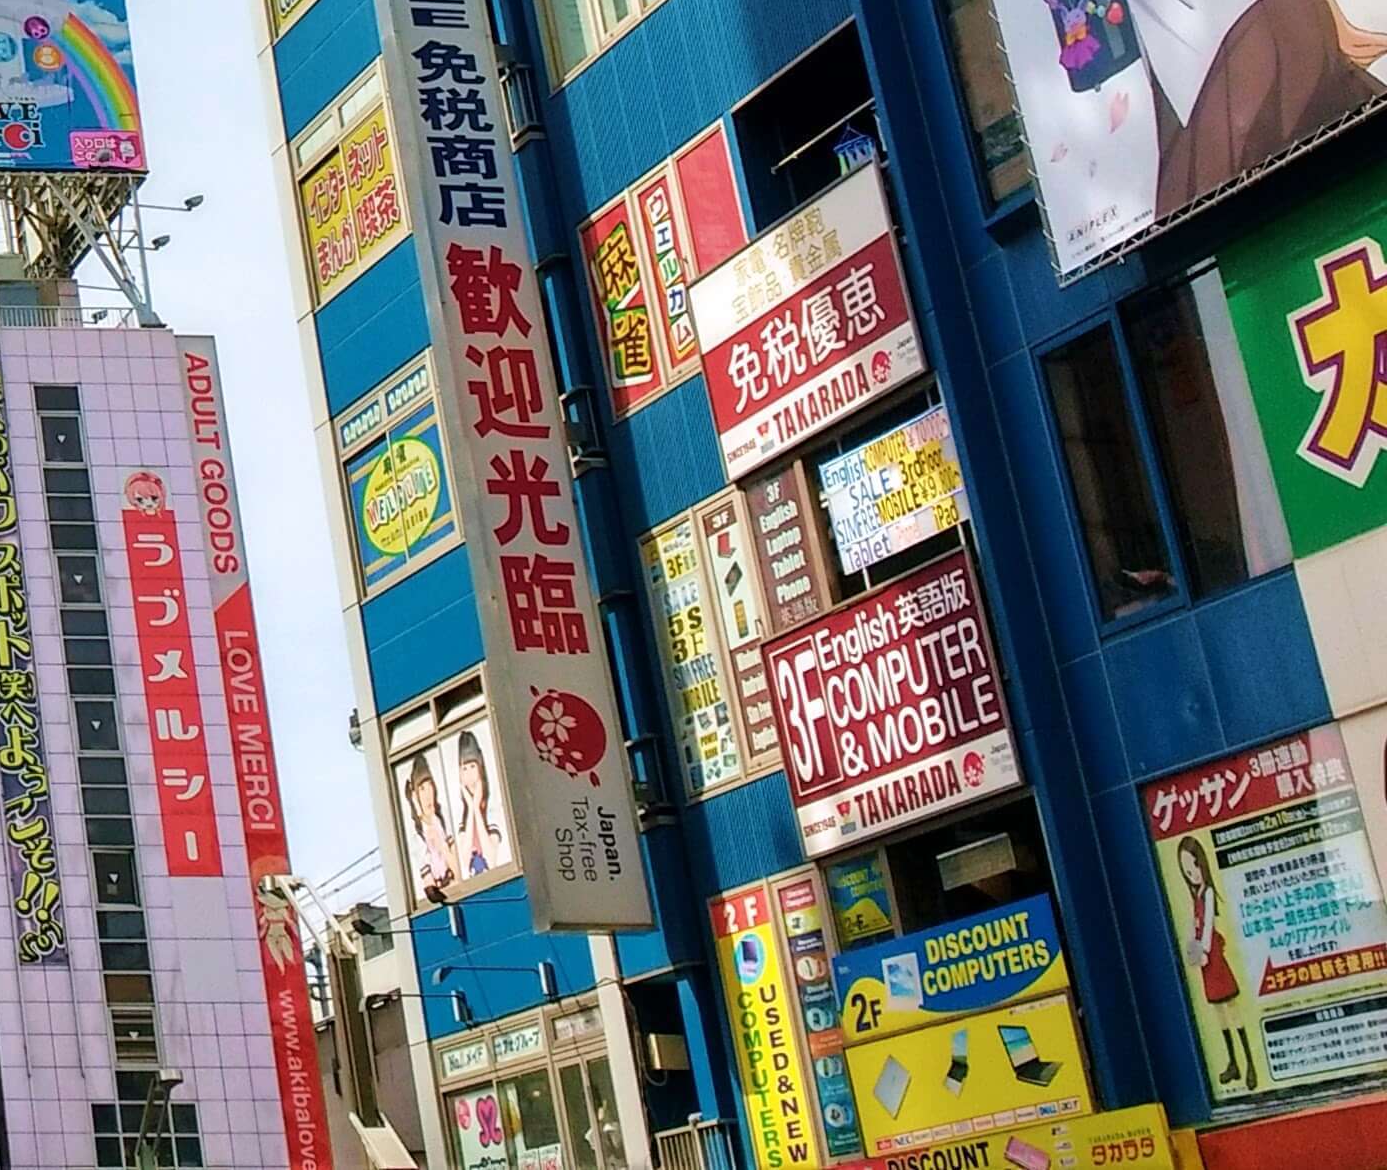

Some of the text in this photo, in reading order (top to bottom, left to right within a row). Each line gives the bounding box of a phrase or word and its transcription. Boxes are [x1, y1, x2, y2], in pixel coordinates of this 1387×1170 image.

[411, 39, 509, 228] 免税商店
[310, 123, 388, 227] インターネット
[317, 177, 401, 285] まんが喫茶
[594, 228, 652, 370] 麻雀
[773, 362, 872, 444] TAKARADA
[183, 352, 240, 577] ADULT GOODS
[445, 242, 591, 658] 歓迎光臨
[849, 470, 890, 510] SALE
[711, 511, 731, 530] 3F
[759, 499, 799, 533] English
[877, 487, 922, 526] MOBILE
[771, 548, 806, 580] Tablet
[776, 574, 812, 606] Phone
[845, 532, 892, 570] Tablet
[816, 567, 971, 671] English 英語版
[133, 530, 203, 863] ラブメルシー
[827, 617, 987, 729] COMPUTER
[223, 629, 276, 832] LOVE MERCI
[778, 648, 826, 783] 3F
[841, 730, 870, 778] &
[866, 674, 1001, 768] MOBILE
[854, 759, 963, 829] TAKARADA
[1152, 767, 1251, 832] ゲッサン
[553, 826, 574, 882] Shop
[570, 796, 599, 882] Tax-free
[596, 804, 618, 882] Japan.
[922, 938, 1051, 998] COMPUTERS
[924, 911, 1030, 965] DISCOUNT
[850, 993, 882, 1033] 2F
[737, 990, 784, 1170] COMPUTERS
[887, 1141, 990, 1170] DISCOUNT
